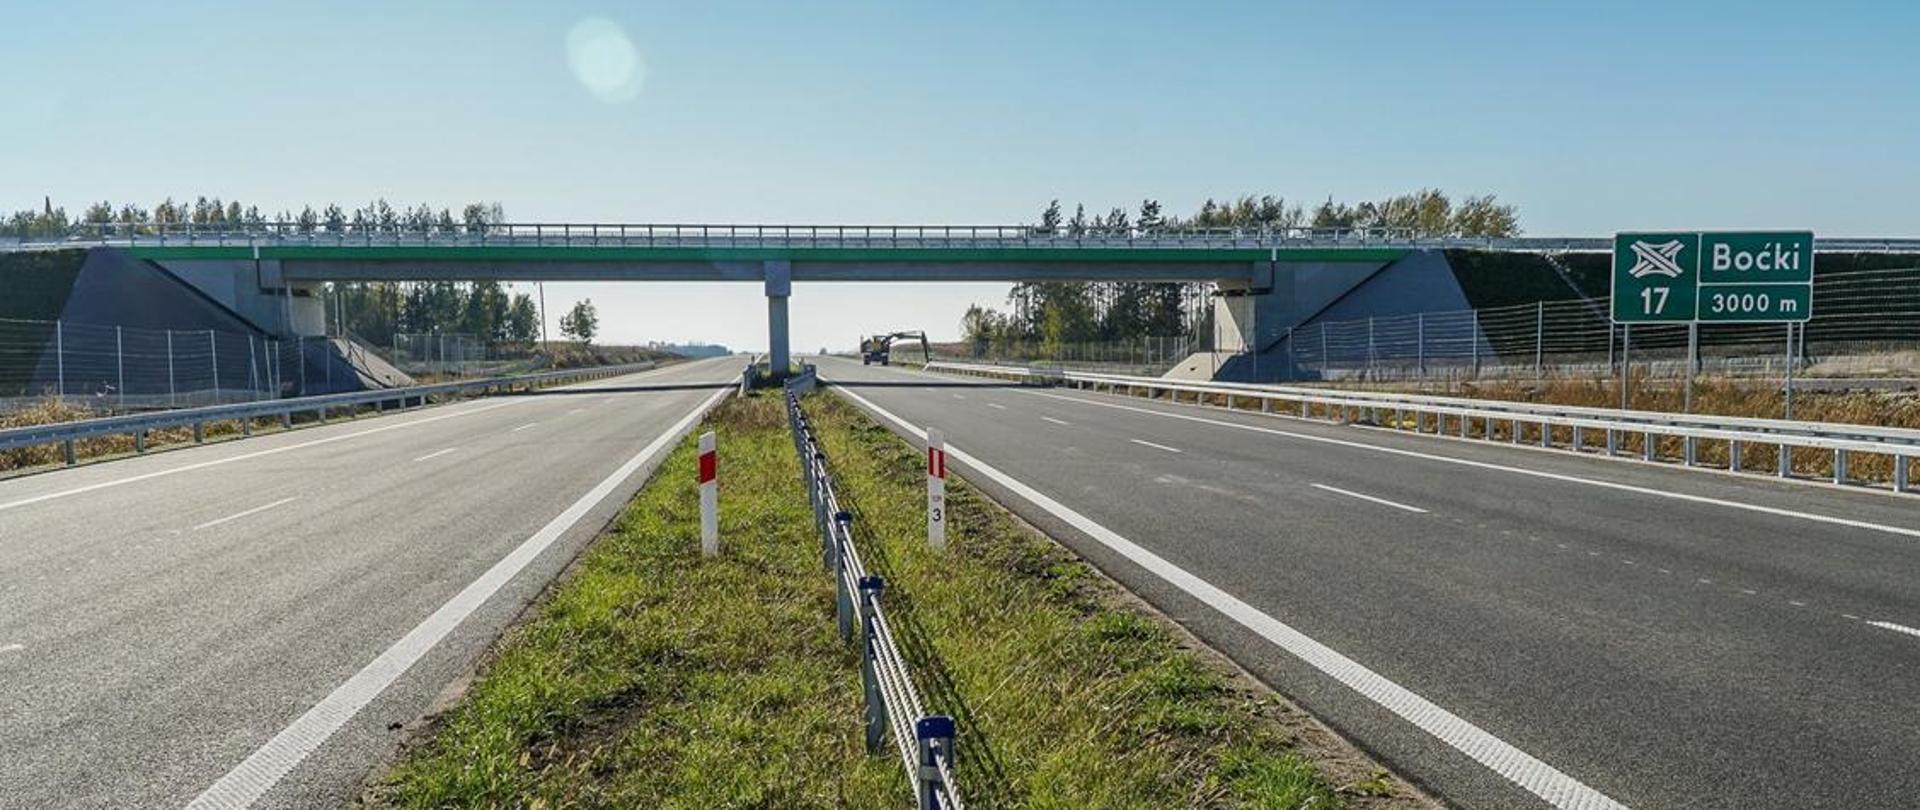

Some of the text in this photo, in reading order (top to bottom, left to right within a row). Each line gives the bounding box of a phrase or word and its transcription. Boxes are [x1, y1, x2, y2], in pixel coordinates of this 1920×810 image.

[1712, 243, 1800, 270] Boćki
[1640, 287, 1670, 315] 17
[1711, 294, 1797, 313] 3000 m
[932, 508, 941, 522] 3
